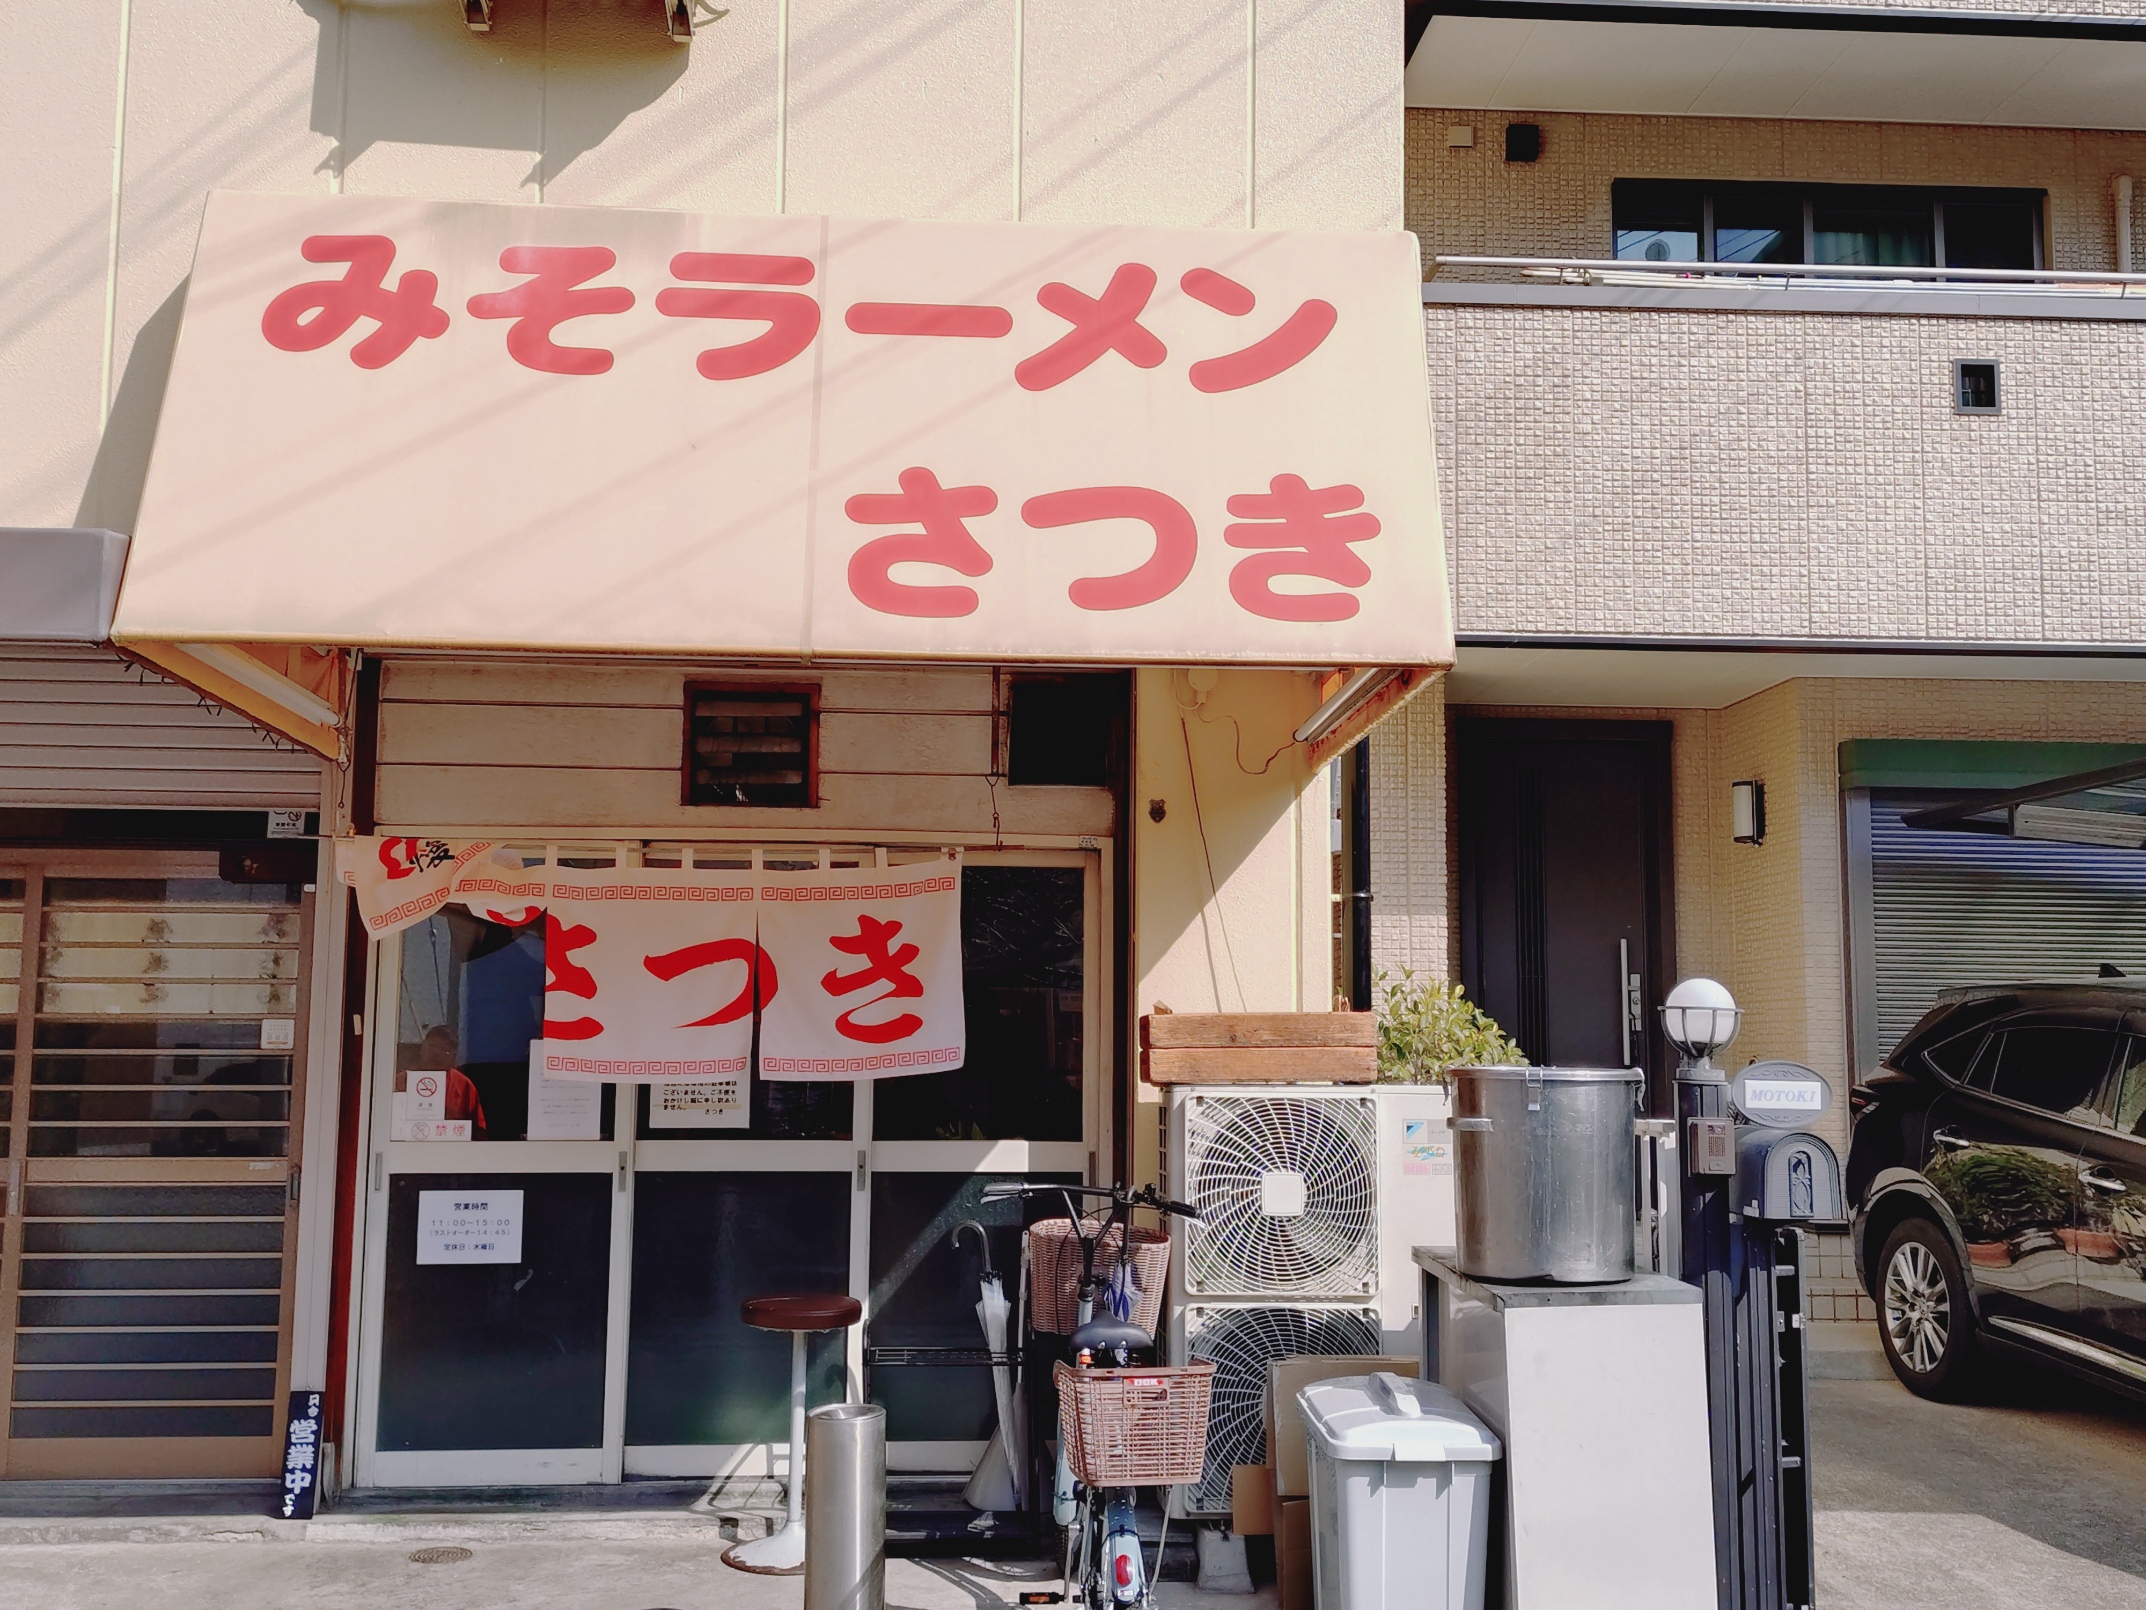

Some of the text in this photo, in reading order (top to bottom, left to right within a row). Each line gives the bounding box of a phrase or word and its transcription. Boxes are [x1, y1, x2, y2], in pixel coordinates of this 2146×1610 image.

[262, 235, 1337, 393] みそラーメン
[845, 467, 1381, 622] さつき
[1749, 1089, 1817, 1103] MOTOKI
[453, 1202, 489, 1211] 営業時間
